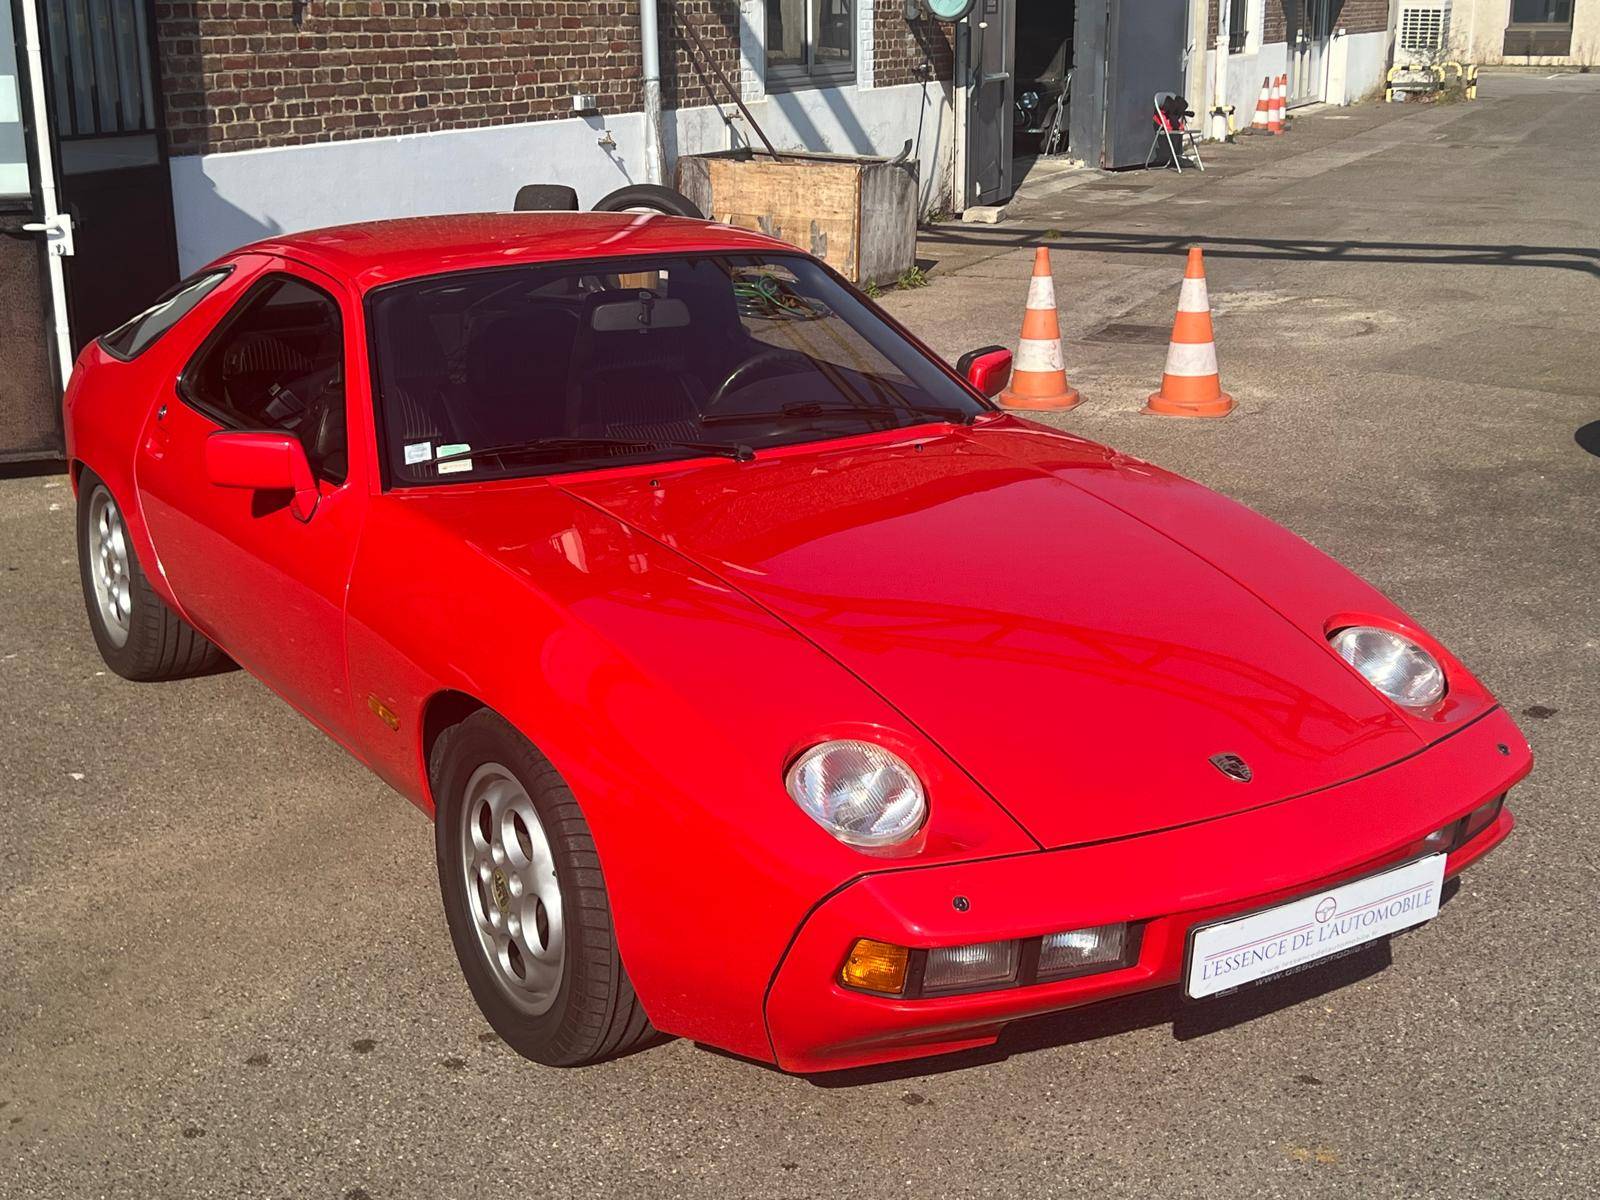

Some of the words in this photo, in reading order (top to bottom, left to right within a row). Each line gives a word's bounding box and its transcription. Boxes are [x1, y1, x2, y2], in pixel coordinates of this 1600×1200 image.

[1203, 938, 1287, 981] L'ESSENCE
[1292, 930, 1314, 951] DE
[1319, 888, 1434, 942] L'AUTOMOBILE
